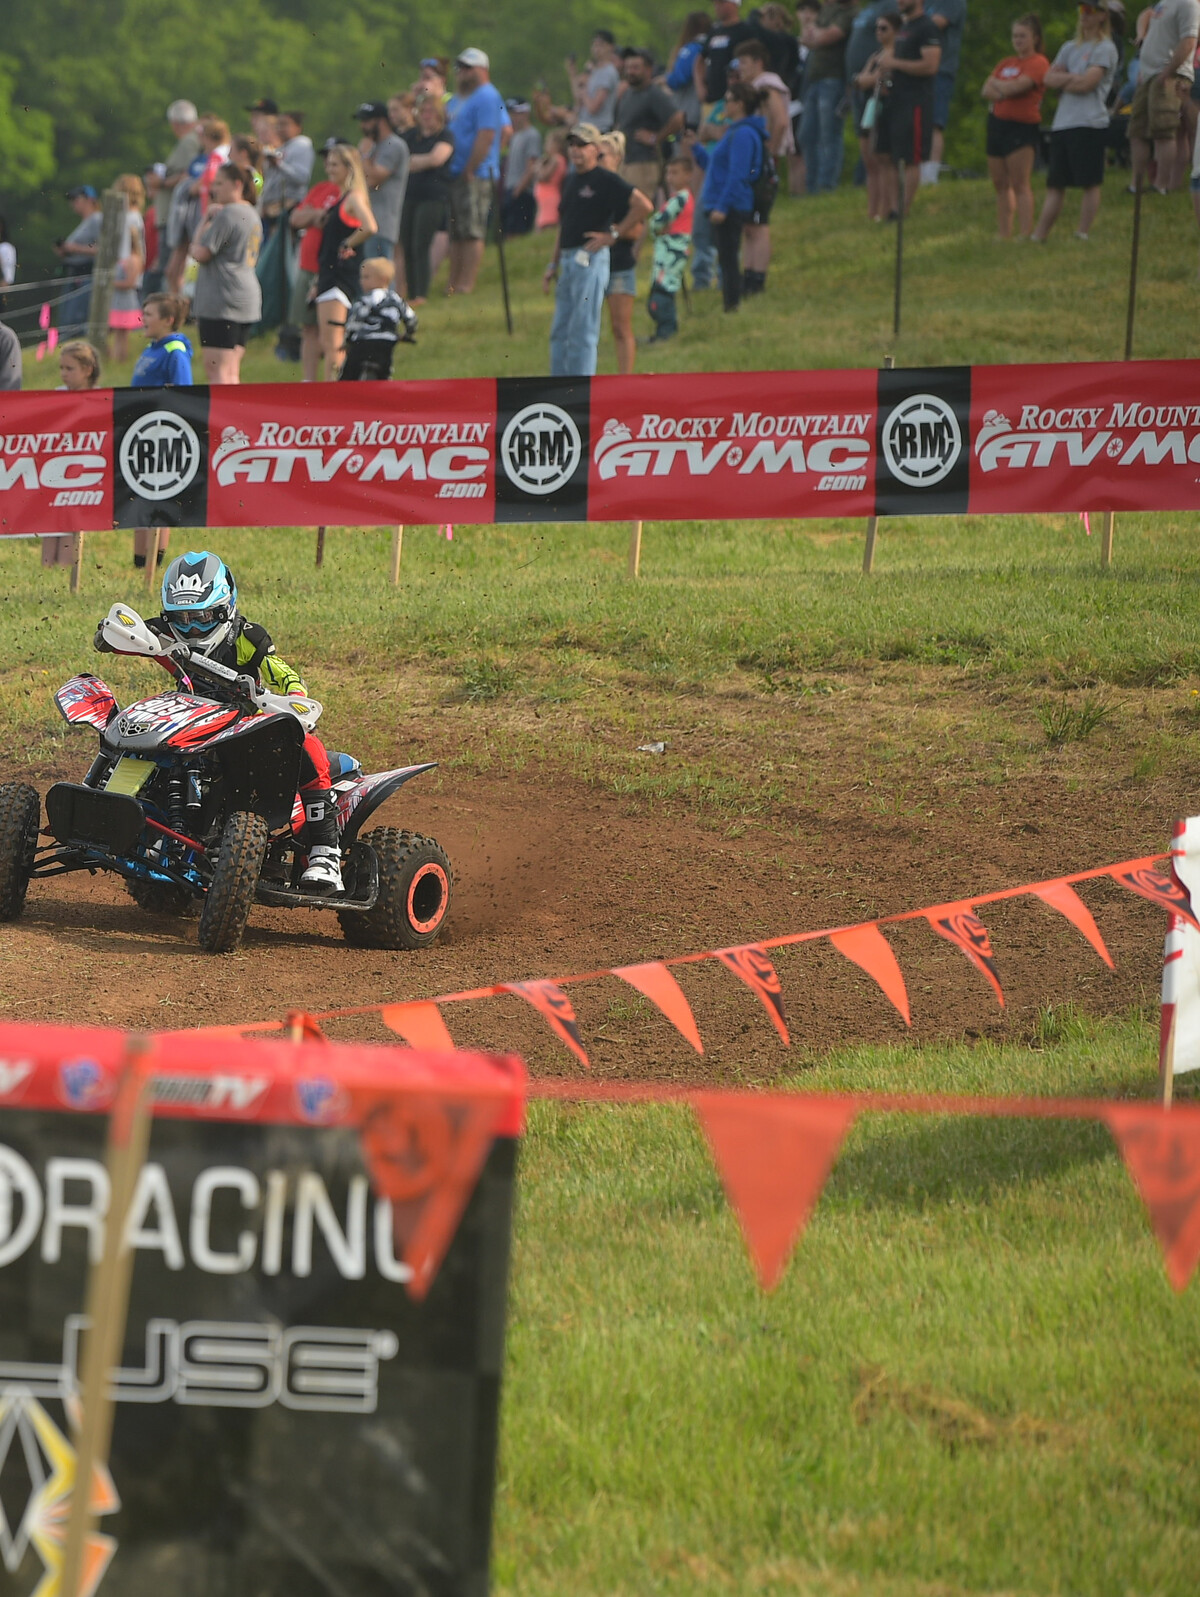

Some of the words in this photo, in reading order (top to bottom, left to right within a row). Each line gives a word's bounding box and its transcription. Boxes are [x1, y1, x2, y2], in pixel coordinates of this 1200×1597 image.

[637, 414, 724, 439] ROCKY
[727, 412, 872, 437] MOUNTAIN
[1017, 405, 1104, 430] ROCKY
[1106, 403, 1200, 427] MOUNT
[255, 422, 344, 447] ROCKY
[347, 421, 491, 445] MOUNTAIN
[518, 430, 564, 468] RM
[899, 421, 947, 460] RM
[135, 437, 184, 473] RM
